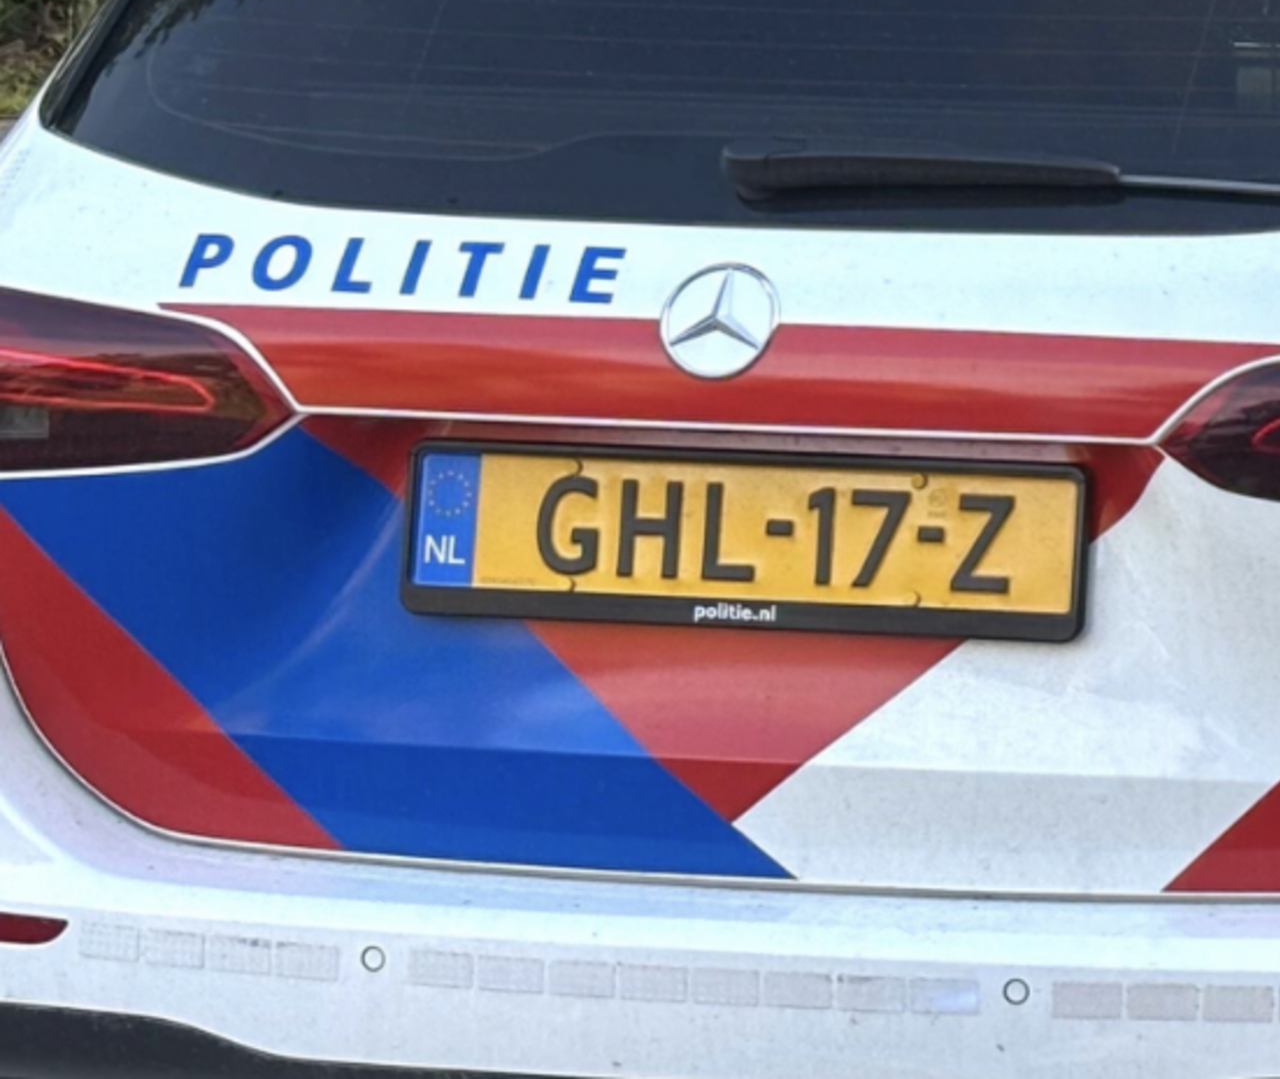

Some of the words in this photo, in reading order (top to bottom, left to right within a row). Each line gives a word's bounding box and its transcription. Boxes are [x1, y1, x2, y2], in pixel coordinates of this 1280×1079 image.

[179, 233, 627, 304] POLITIE
[424, 534, 466, 564] NL
[535, 474, 1016, 594] GHL-17-Z
[694, 602, 778, 623] politie.nl
